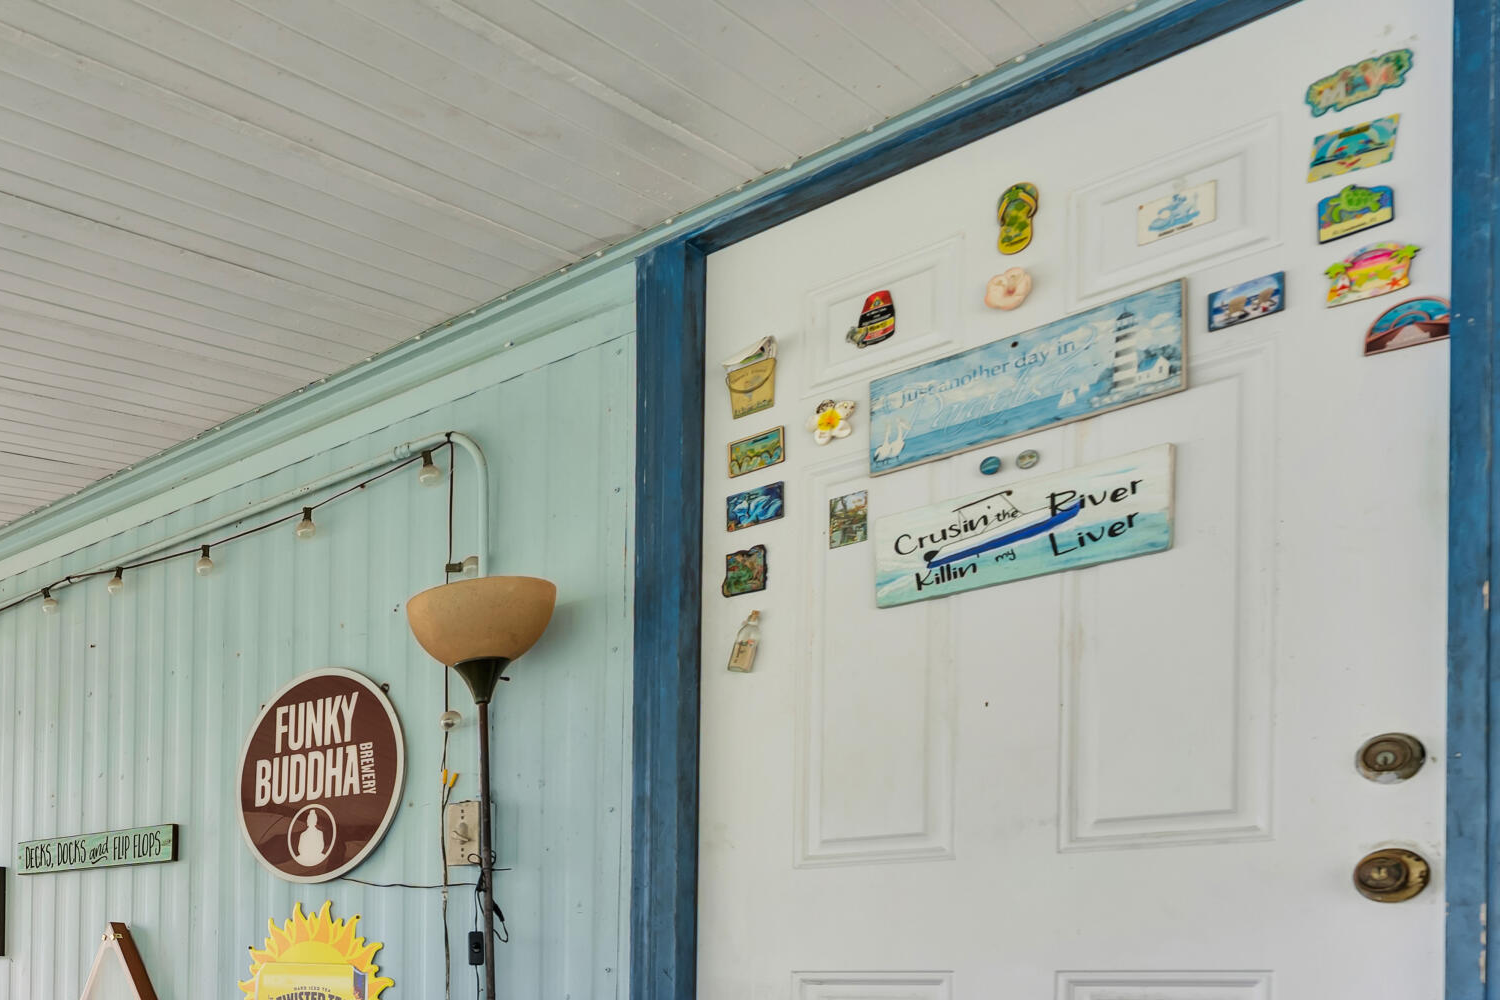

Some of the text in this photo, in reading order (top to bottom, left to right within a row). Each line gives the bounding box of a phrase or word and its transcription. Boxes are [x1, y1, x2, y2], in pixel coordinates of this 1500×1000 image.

[938, 361, 1010, 392] another
[1014, 350, 1050, 370] day
[1057, 340, 1076, 356] in
[995, 509, 1019, 522] the
[1045, 479, 1143, 517] River
[994, 548, 1017, 562] my
[1048, 511, 1140, 557] Liver
[275, 691, 359, 754] FUNKY
[254, 744, 361, 808] BUDDHA
[359, 741, 377, 795] BREWERY
[57, 839, 87, 866] DOCKS
[89, 836, 109, 861] and
[113, 835, 131, 861] FLIP
[133, 830, 161, 858] FLOPS
